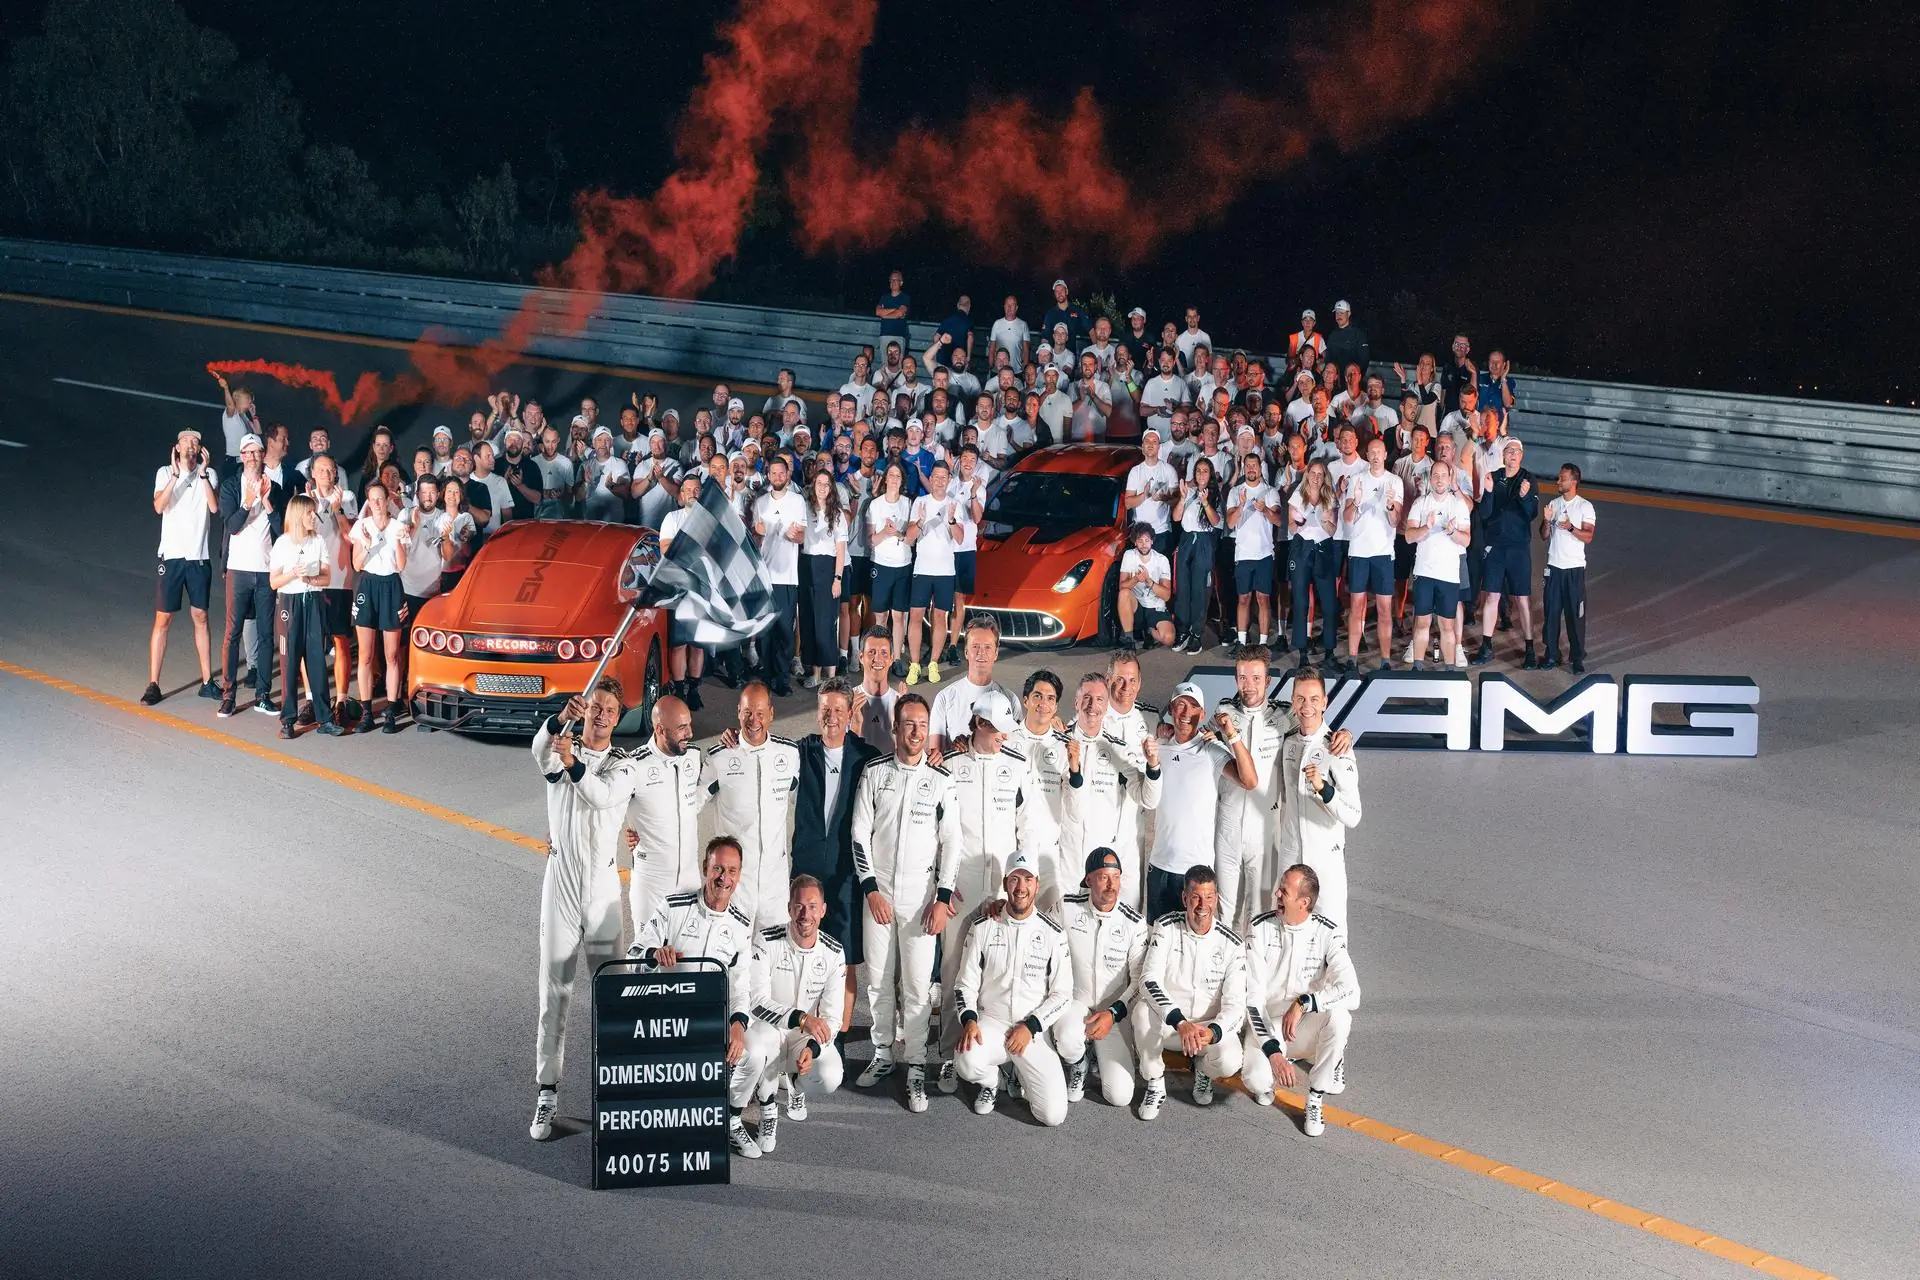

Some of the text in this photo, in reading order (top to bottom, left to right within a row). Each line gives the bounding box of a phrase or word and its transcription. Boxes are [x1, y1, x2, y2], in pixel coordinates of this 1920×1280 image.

[486, 639, 537, 650] RECORD
[1341, 673, 1760, 756] AMG
[633, 1018, 689, 1039] A NEW
[599, 1061, 724, 1085] DIMENSION OF
[599, 1106, 724, 1131] PERFORMANCE
[605, 1151, 710, 1175] 40075 KM
